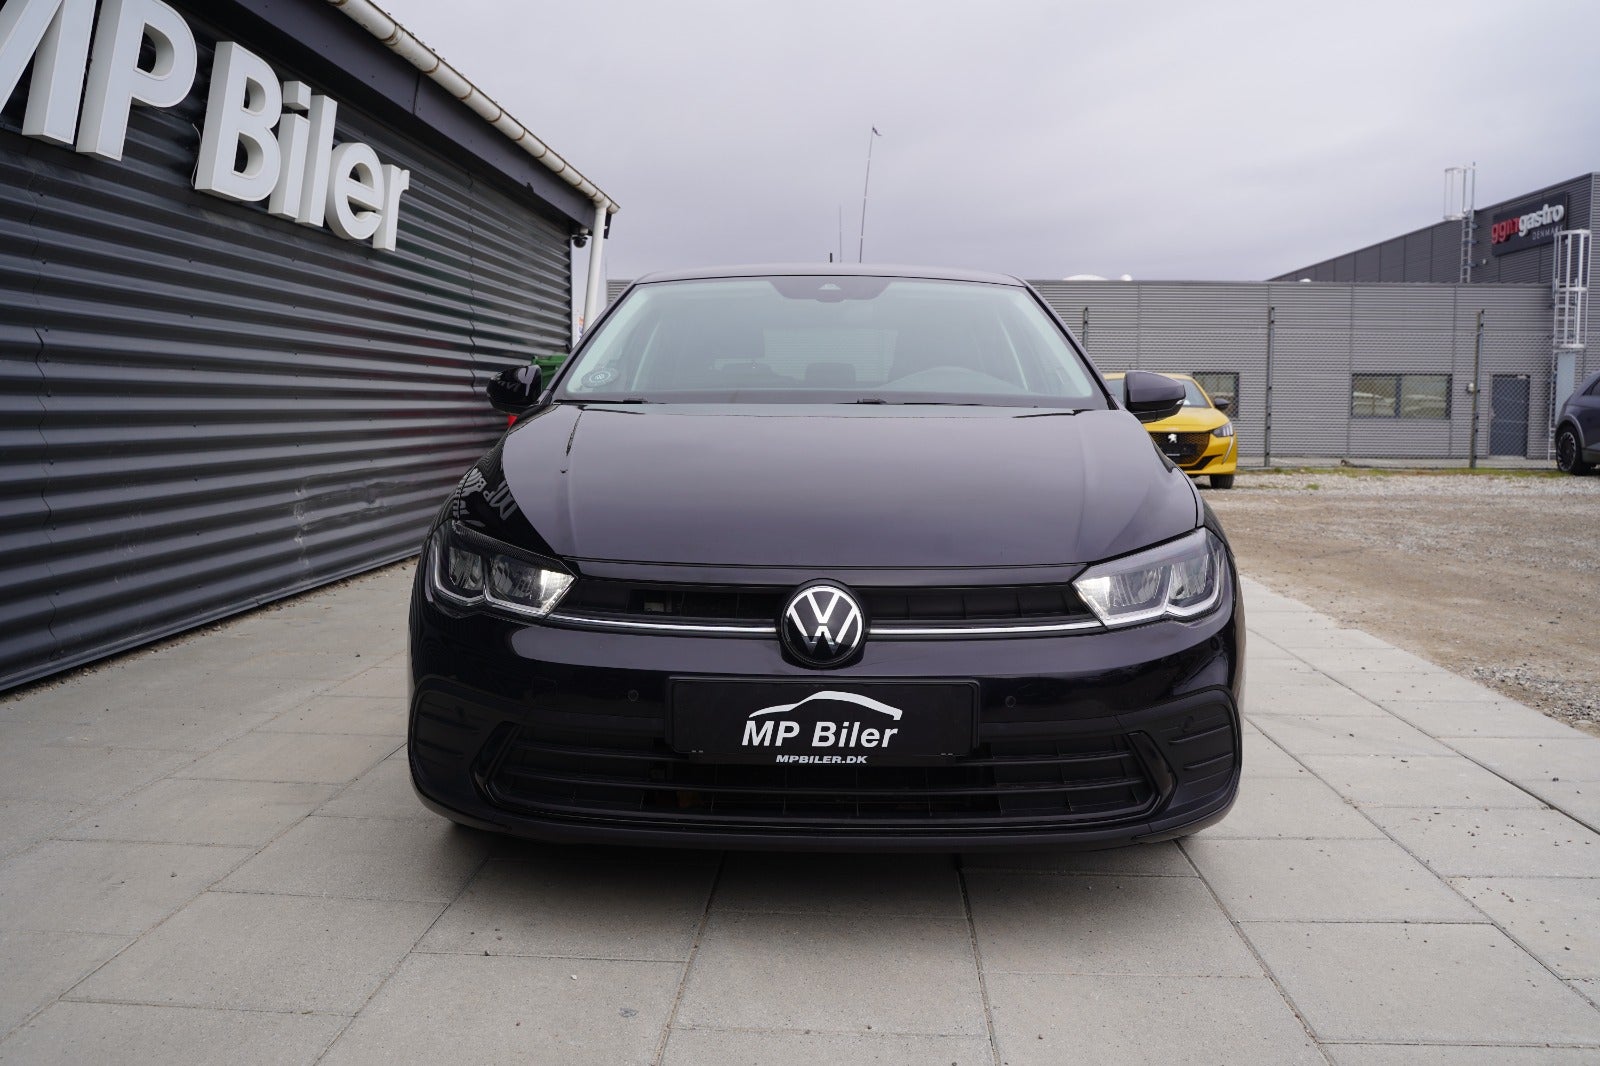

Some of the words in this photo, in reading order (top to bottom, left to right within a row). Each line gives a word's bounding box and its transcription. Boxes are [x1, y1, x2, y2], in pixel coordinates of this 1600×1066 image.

[195, 41, 409, 251] Biler
[741, 720, 800, 747] MP
[811, 721, 899, 748] Biler
[775, 754, 868, 765] MPBILER.DK
